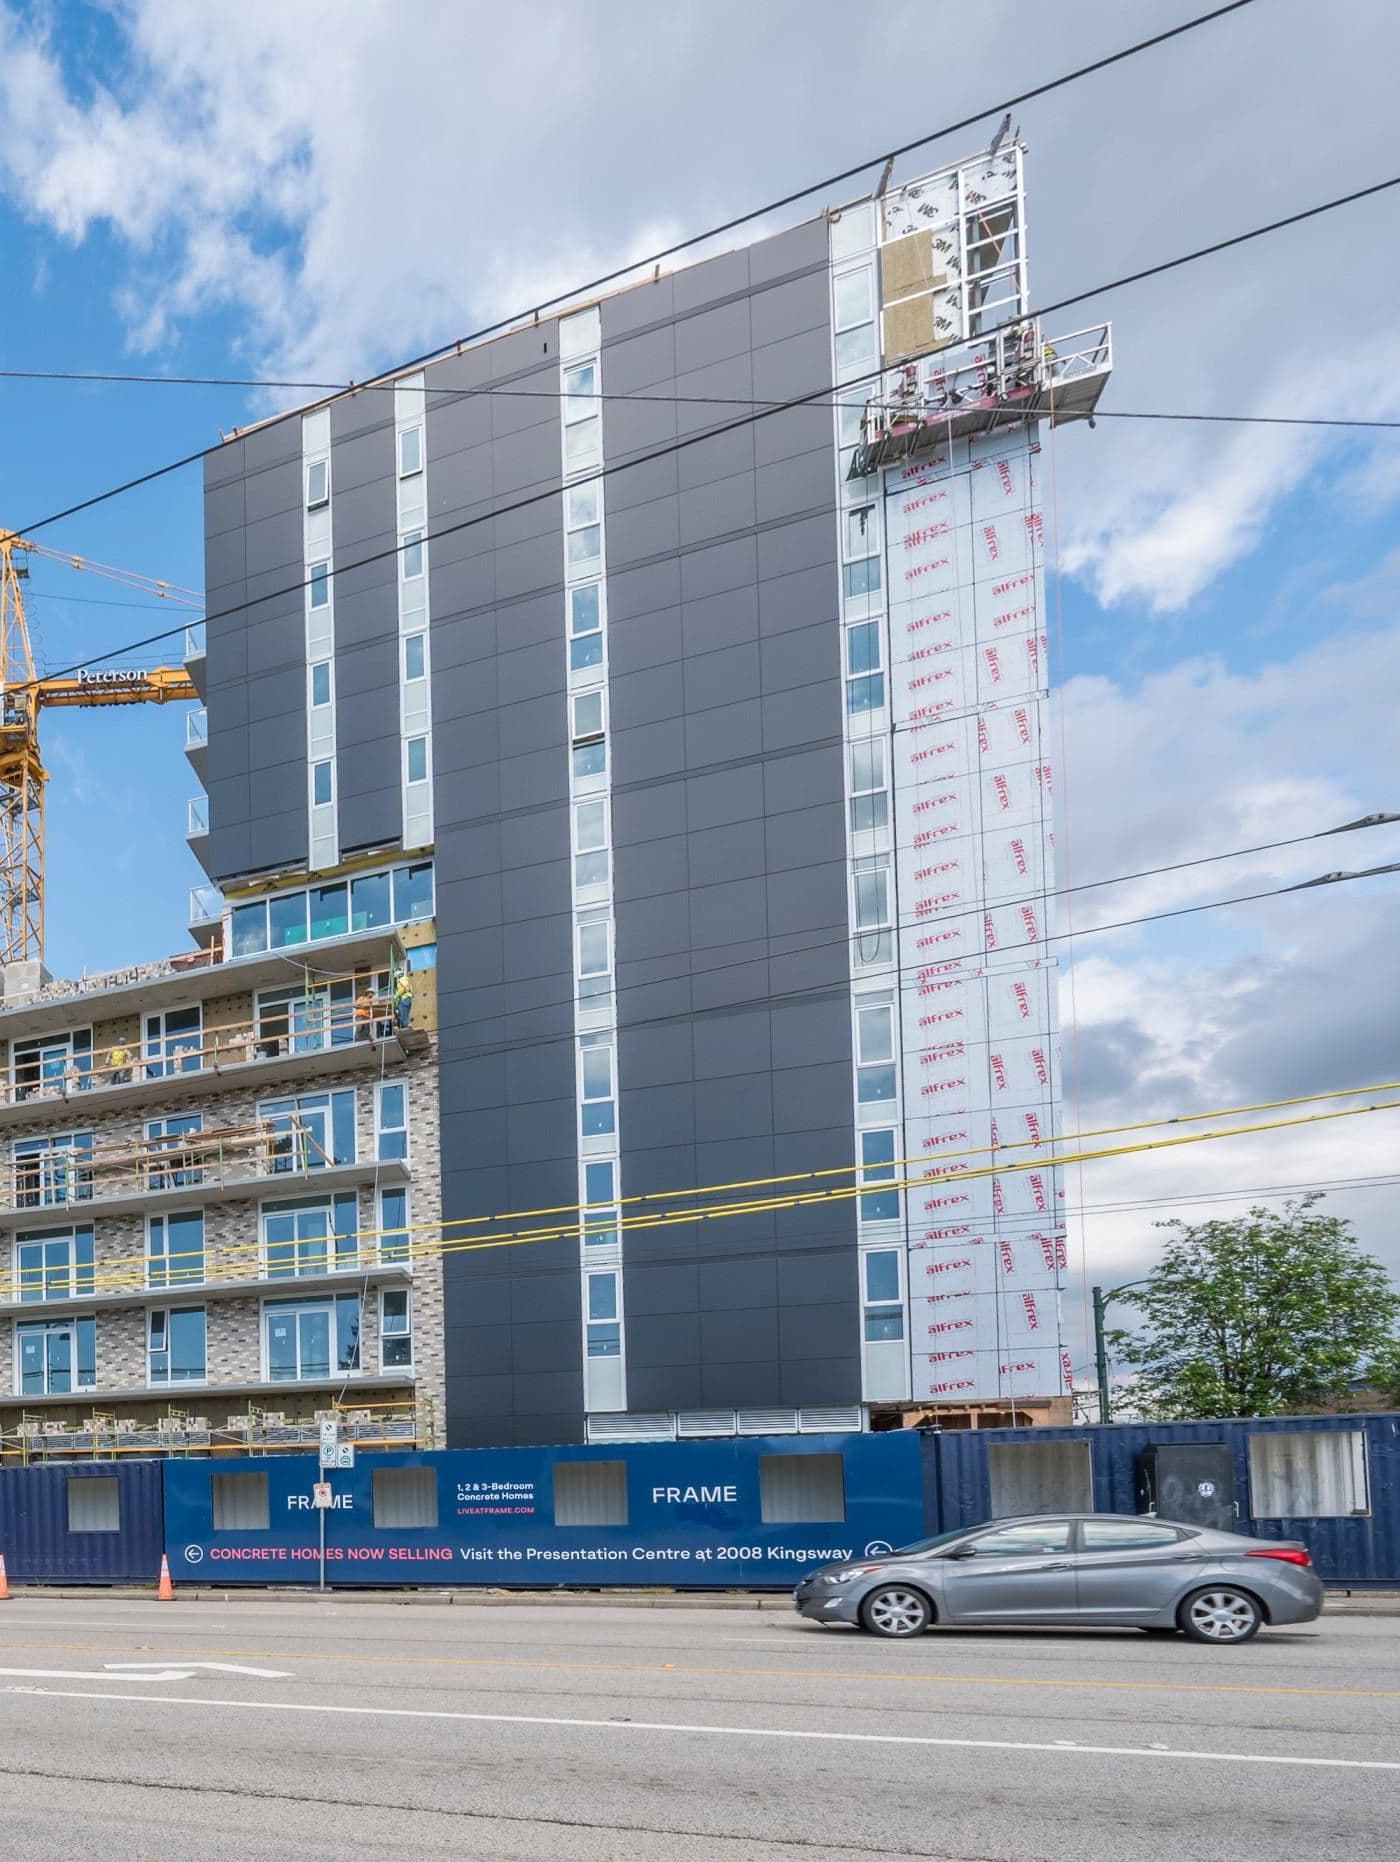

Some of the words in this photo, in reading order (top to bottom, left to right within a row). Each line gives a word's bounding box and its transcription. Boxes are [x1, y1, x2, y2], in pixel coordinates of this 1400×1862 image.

[77, 669, 147, 684] Peterson
[465, 1483, 471, 1491] 2
[473, 1483, 479, 1491] &
[481, 1482, 534, 1491] 3-Bedroom
[457, 1493, 500, 1501] Concrete
[502, 1492, 534, 1500] Homes
[652, 1486, 737, 1503] FRAME
[287, 1495, 353, 1510] FRME
[457, 1507, 535, 1515] LIVEATFRAME.COM
[210, 1548, 287, 1560] CONCRETE
[291, 1548, 344, 1560] HOMES
[348, 1548, 385, 1560] NOW
[388, 1548, 453, 1560] SELLING
[460, 1548, 494, 1560] Visit
[497, 1548, 523, 1560] the
[526, 1548, 628, 1560] Presentation
[632, 1548, 691, 1560] Centre
[695, 1548, 712, 1560] at
[716, 1547, 762, 1560] 2008
[767, 1547, 853, 1562] Kingsway
